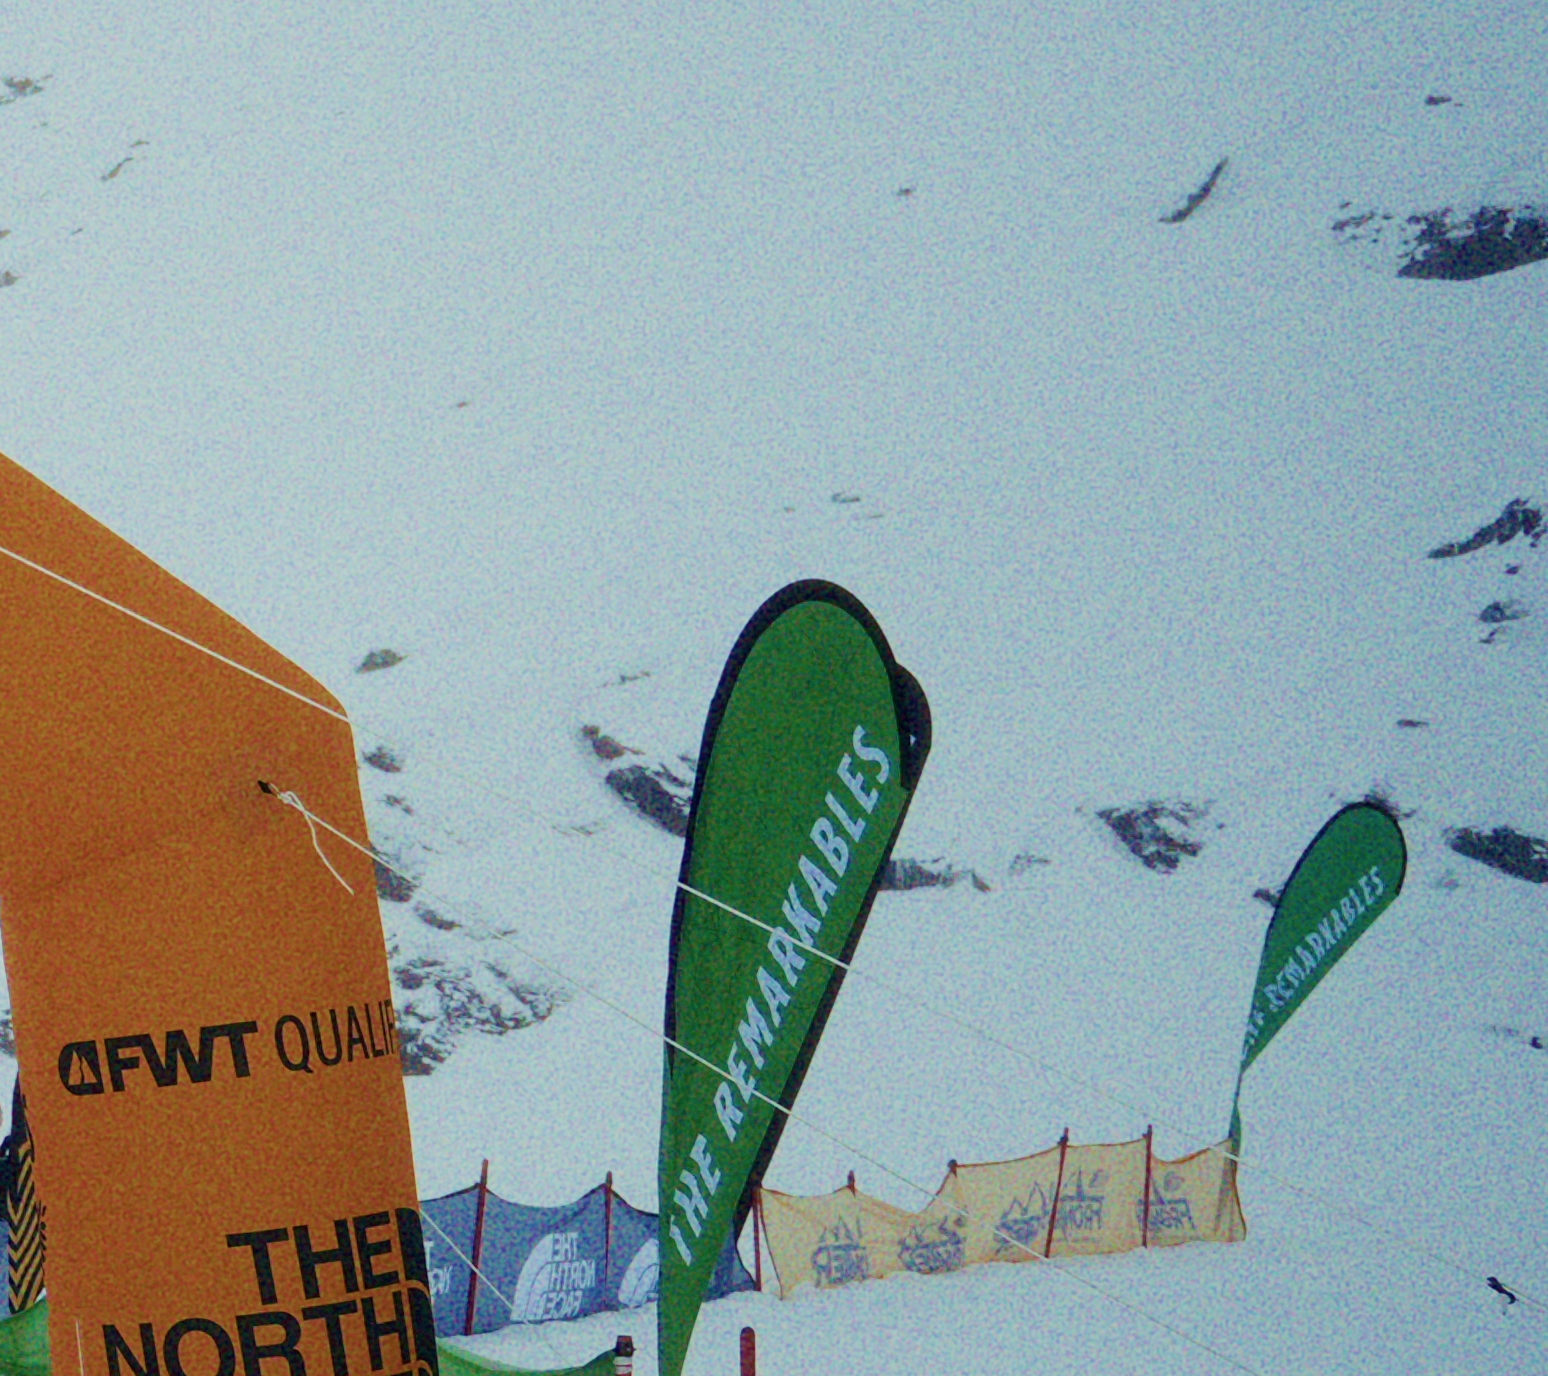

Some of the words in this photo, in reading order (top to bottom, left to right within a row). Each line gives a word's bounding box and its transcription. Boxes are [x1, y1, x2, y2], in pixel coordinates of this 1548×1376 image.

[667, 1134, 722, 1266] THE
[713, 725, 890, 1143] REMARKABLES
[1264, 866, 1384, 1012] REMARKABLES
[104, 1021, 259, 1092] FWT
[226, 1211, 400, 1305] THE
